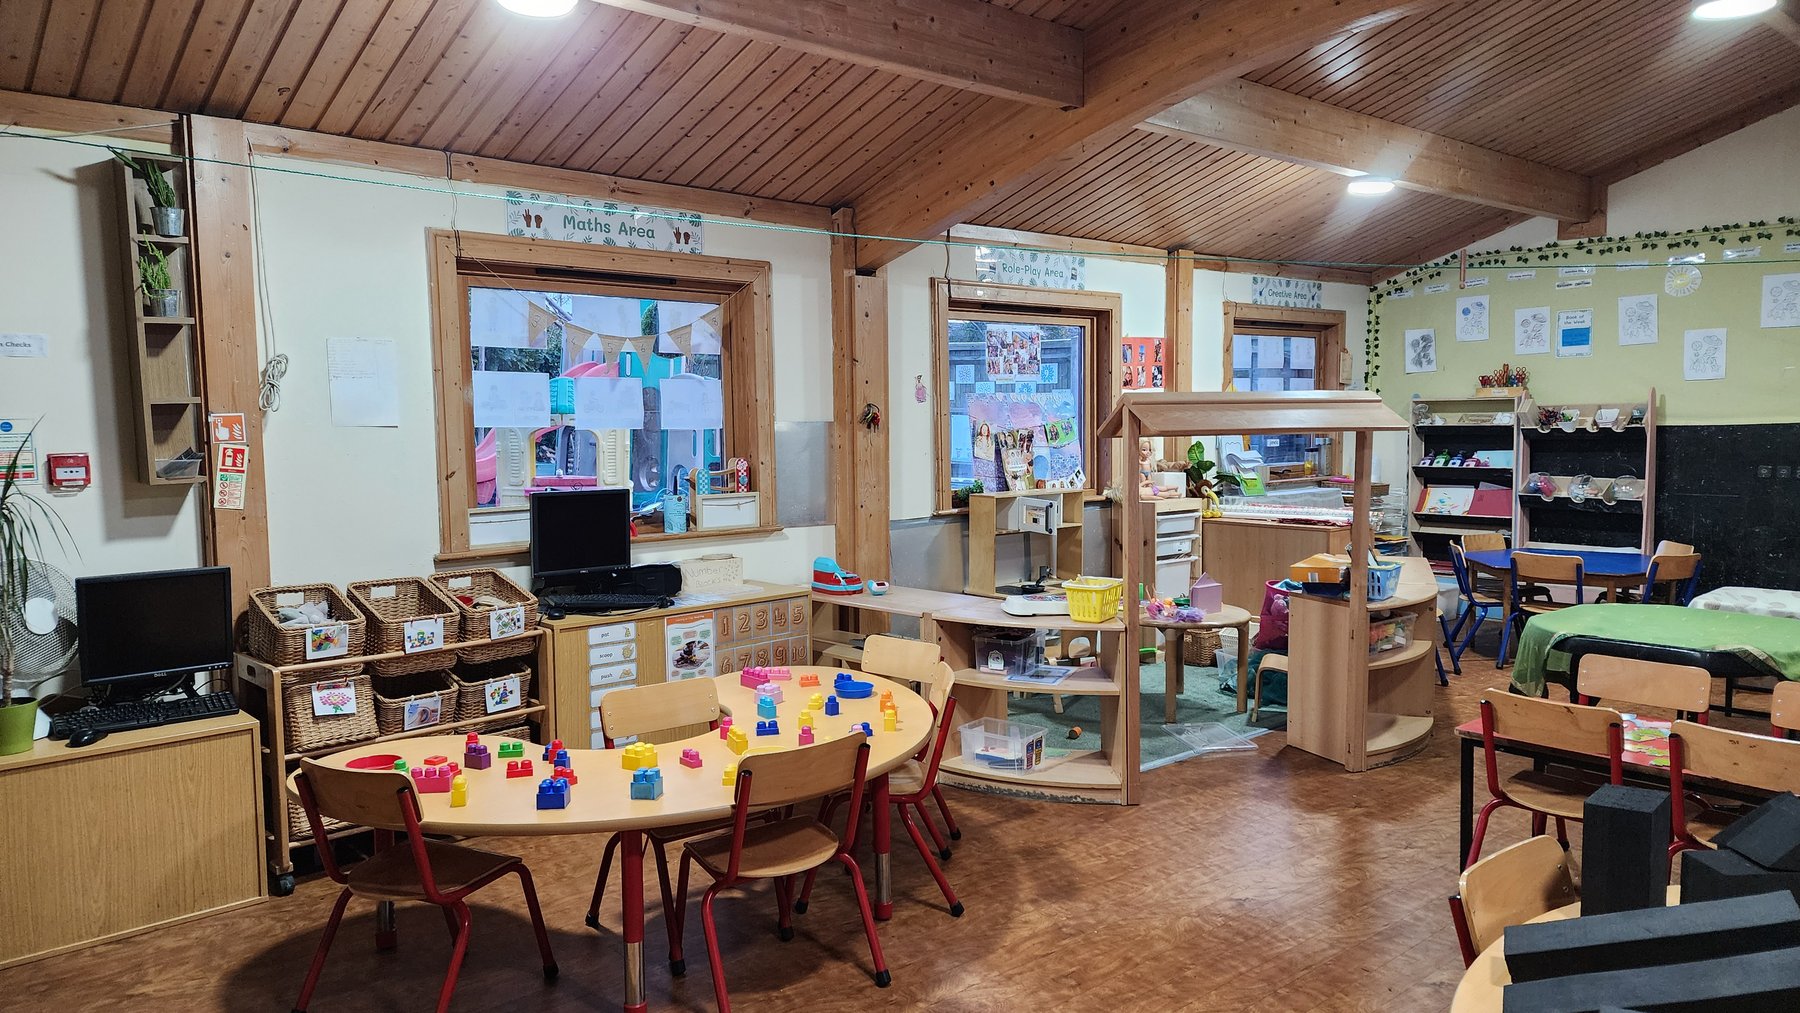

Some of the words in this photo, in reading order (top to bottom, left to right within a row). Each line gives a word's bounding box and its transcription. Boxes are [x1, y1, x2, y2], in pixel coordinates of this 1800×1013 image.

[563, 215, 611, 234] Maths
[618, 221, 655, 239] Area
[1002, 262, 1042, 279] Role-Play
[1045, 267, 1063, 278] Area
[1267, 288, 1292, 299] Creative
[1293, 291, 1307, 300] Area
[722, 616, 729, 635] 1
[739, 613, 751, 632] 2
[756, 610, 769, 629] 3
[774, 608, 786, 626] 4
[793, 606, 804, 624] 5
[722, 657, 732, 674] 6
[740, 654, 751, 668] 7
[758, 650, 769, 668] 8
[776, 646, 787, 665] 9
[792, 646, 806, 662] 10
